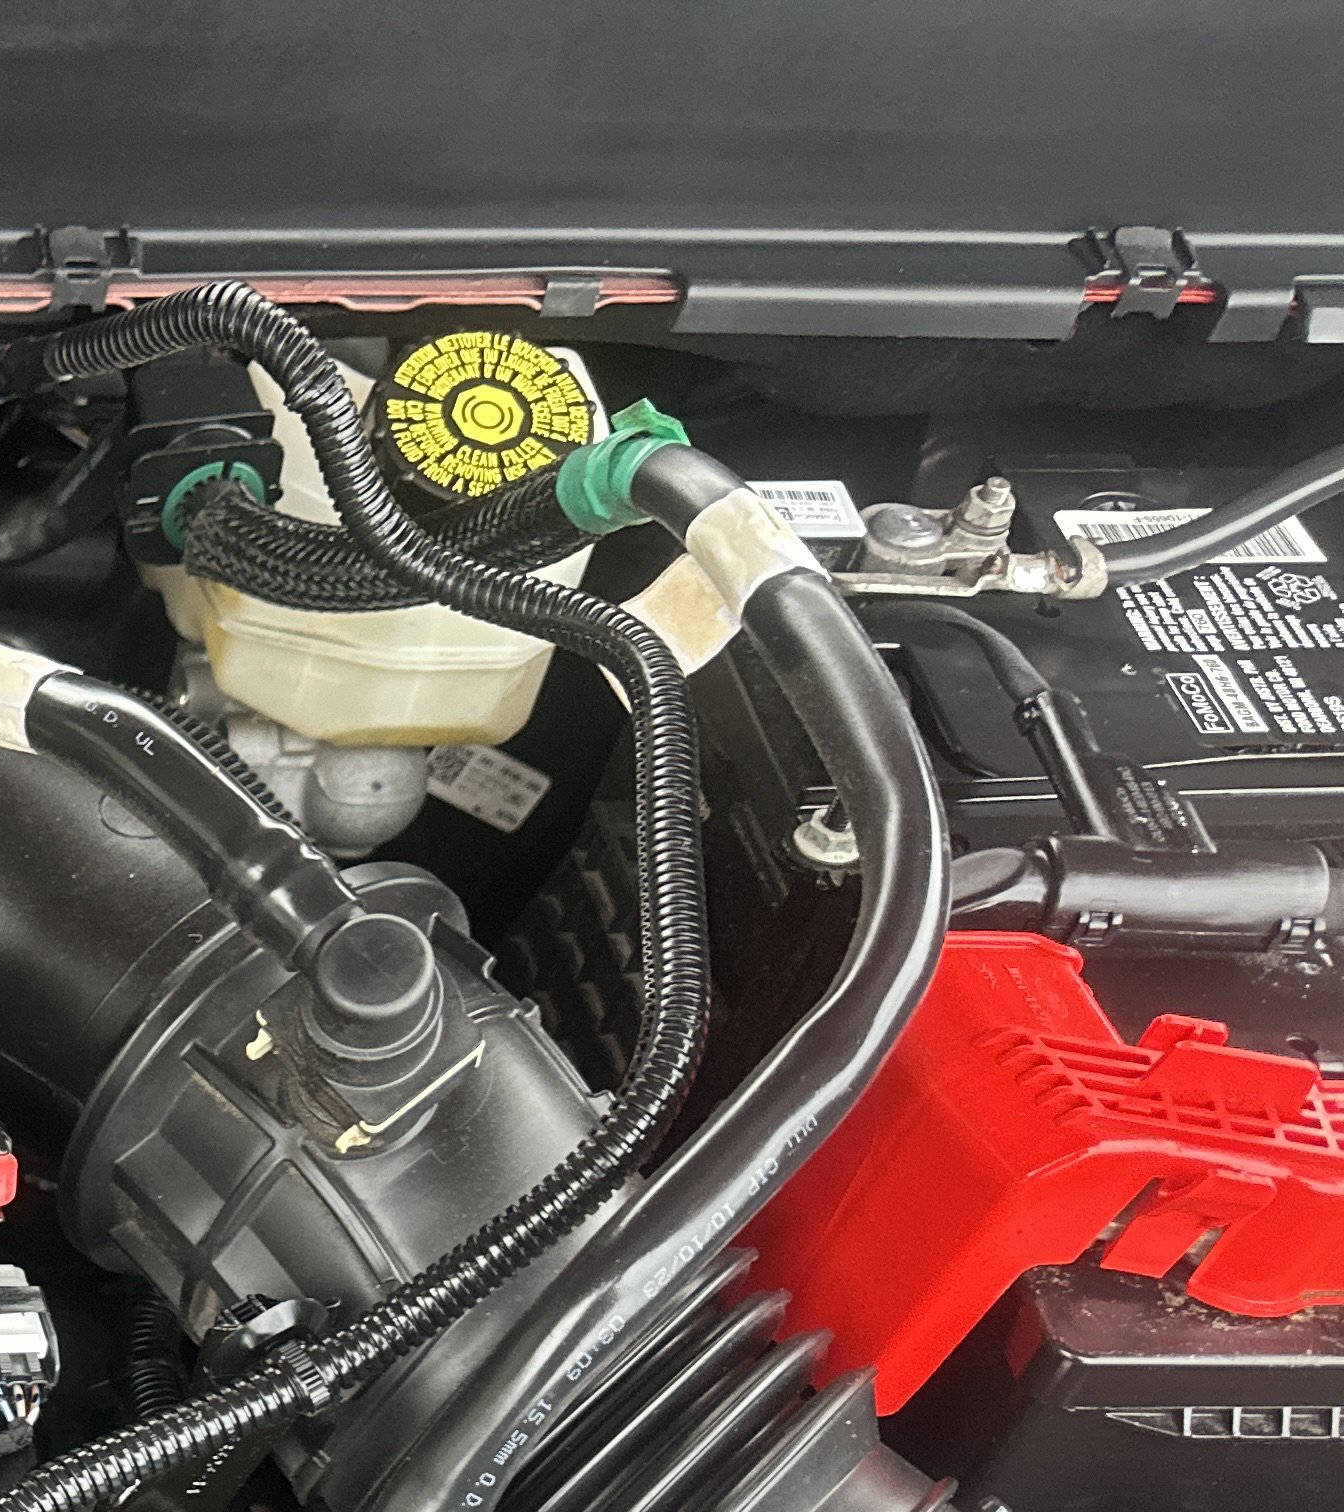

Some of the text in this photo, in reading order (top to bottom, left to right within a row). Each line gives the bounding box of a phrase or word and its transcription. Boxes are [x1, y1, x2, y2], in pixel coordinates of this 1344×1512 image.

[484, 350, 498, 364] DU
[494, 334, 511, 351] LE
[394, 432, 424, 463] FLUID
[417, 461, 454, 487] FROM
[440, 454, 501, 484] REMOVING
[456, 445, 498, 467] CLEAN
[1190, 613, 1211, 630] 760
[1180, 675, 1225, 732] FoMoCo
[1272, 683, 1301, 711] MOTOR
[135, 731, 155, 756] VL
[747, 1157, 778, 1195] CIP
[642, 1204, 735, 1299] 10/10/23
[566, 1315, 625, 1381] 03:09
